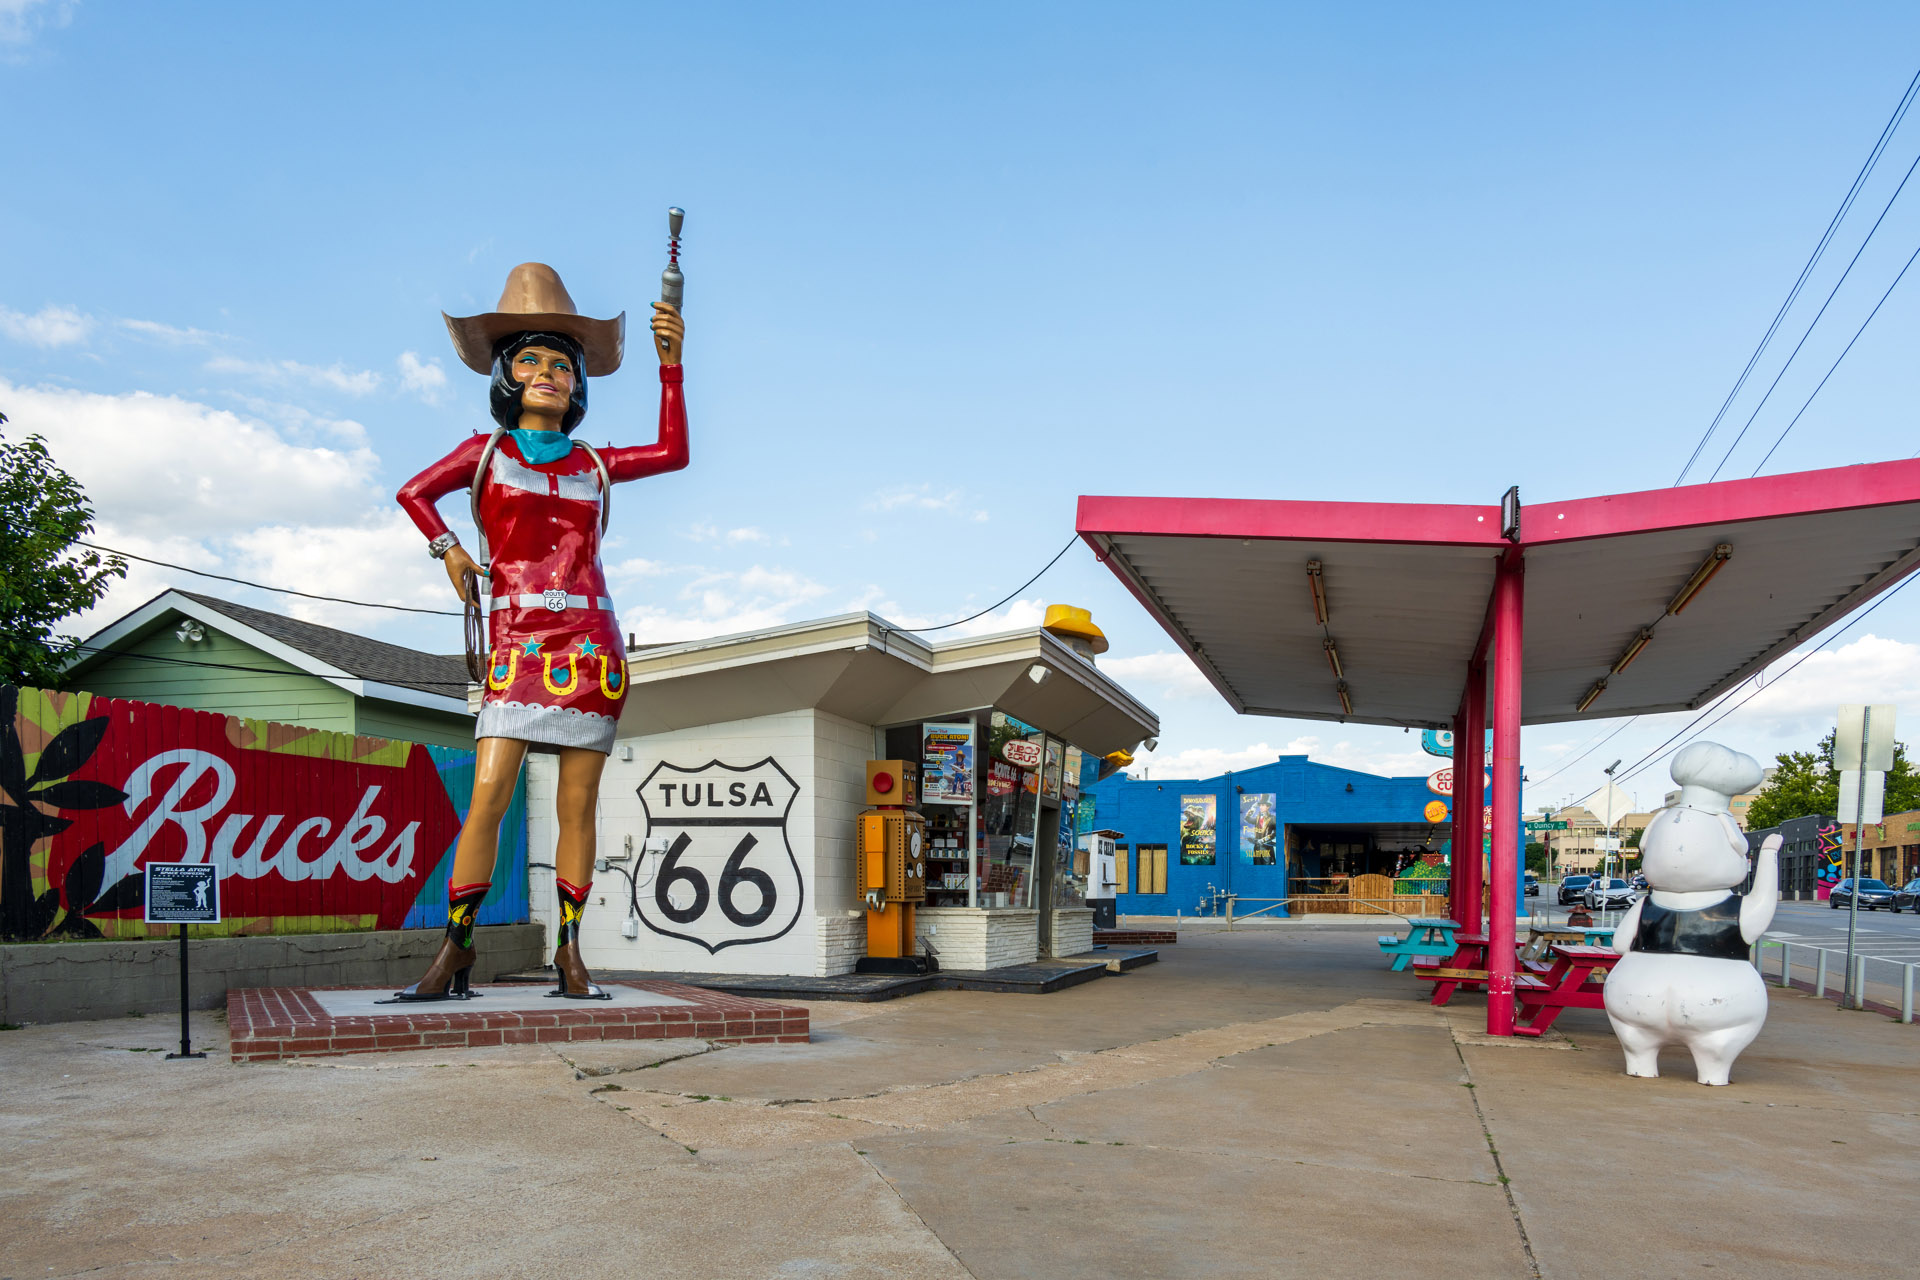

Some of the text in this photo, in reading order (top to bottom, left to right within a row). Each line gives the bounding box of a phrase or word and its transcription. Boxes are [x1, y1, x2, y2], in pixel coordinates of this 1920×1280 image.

[549, 598, 563, 609] 66
[659, 782, 774, 807] TULSA
[93, 748, 422, 904] Bucks
[655, 831, 777, 927] 66
